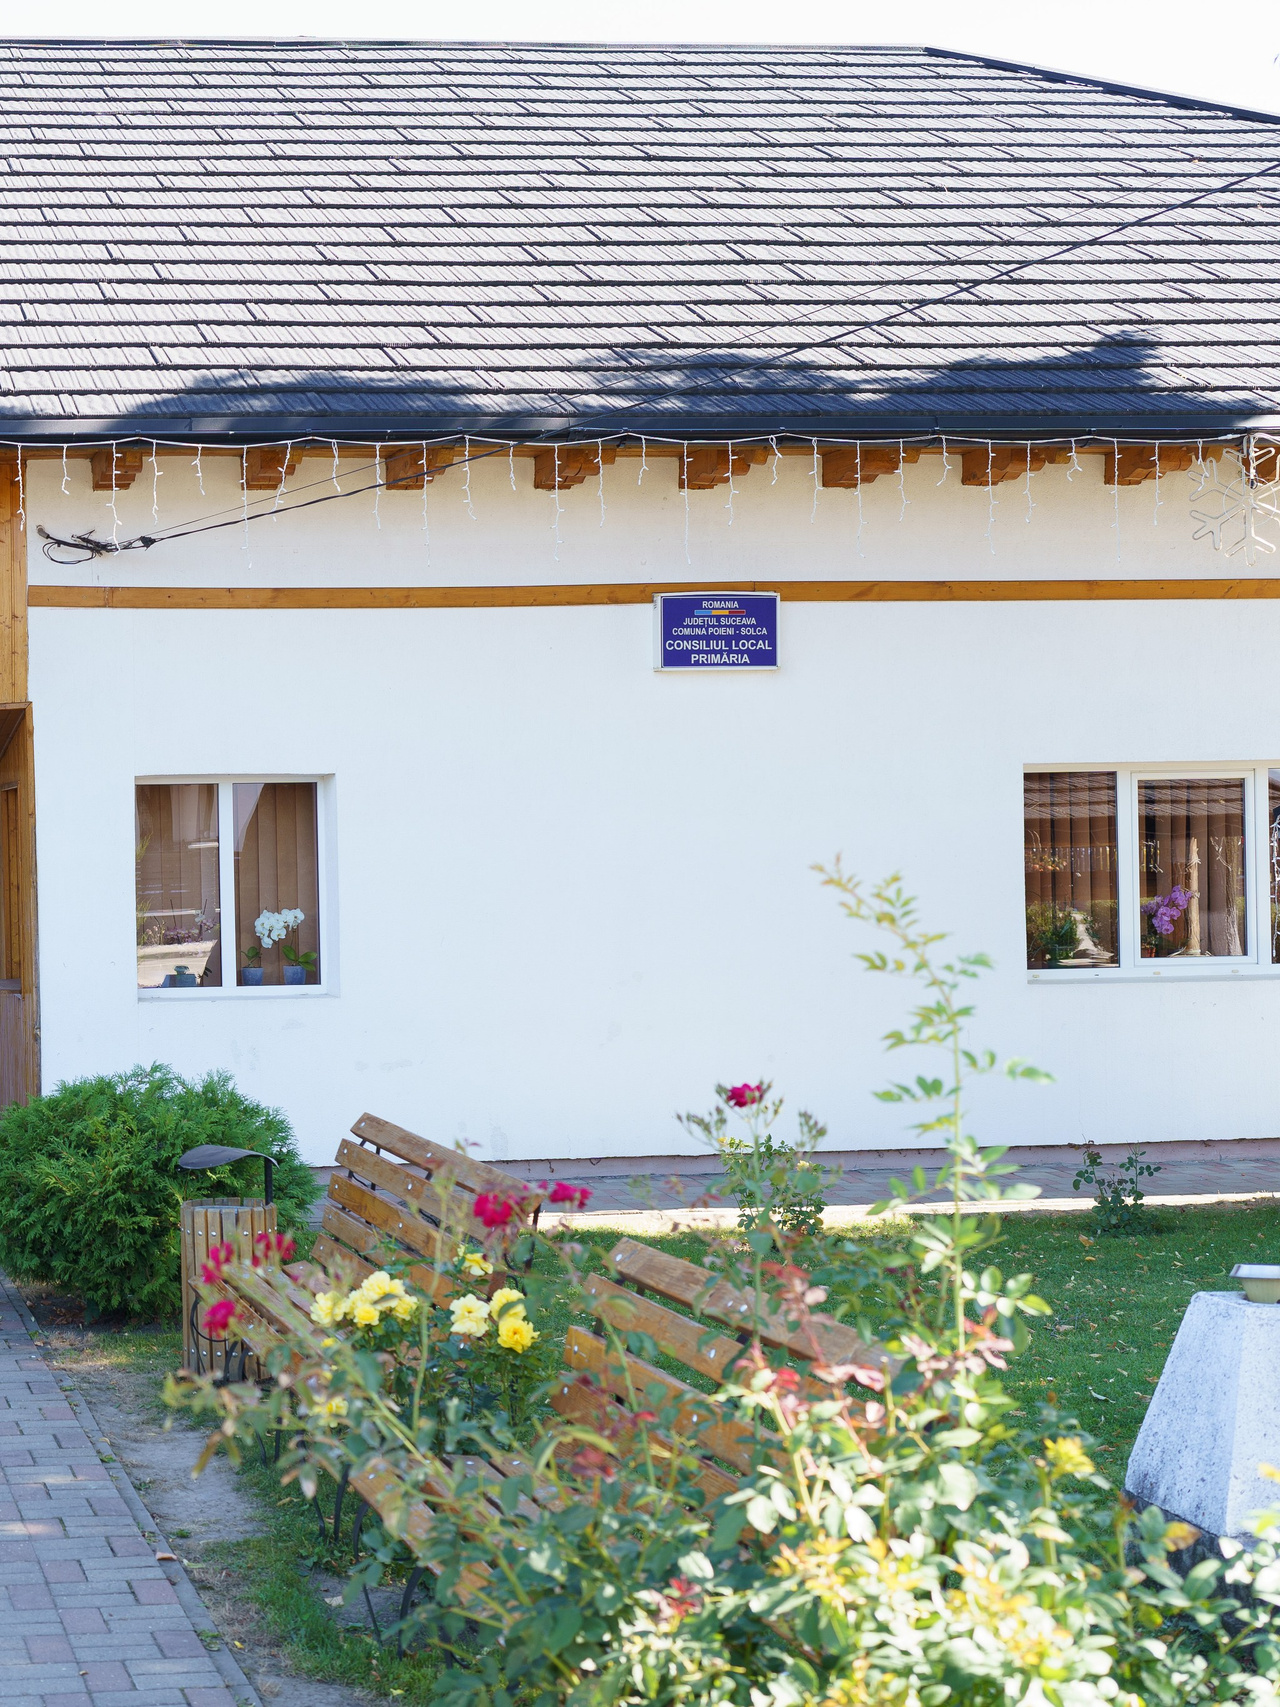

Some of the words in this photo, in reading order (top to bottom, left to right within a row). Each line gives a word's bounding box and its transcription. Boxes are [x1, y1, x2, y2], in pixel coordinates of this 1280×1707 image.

[702, 600, 739, 609] ROMANIA
[720, 617, 757, 625] SUCEAVA
[672, 627, 707, 635] COMUNA
[708, 627, 734, 635] POIENI
[740, 627, 768, 635] SOLCA
[665, 640, 729, 650] CONSILIUL
[732, 640, 772, 650] LOCAL
[691, 651, 750, 664] PRIMĂRIA
